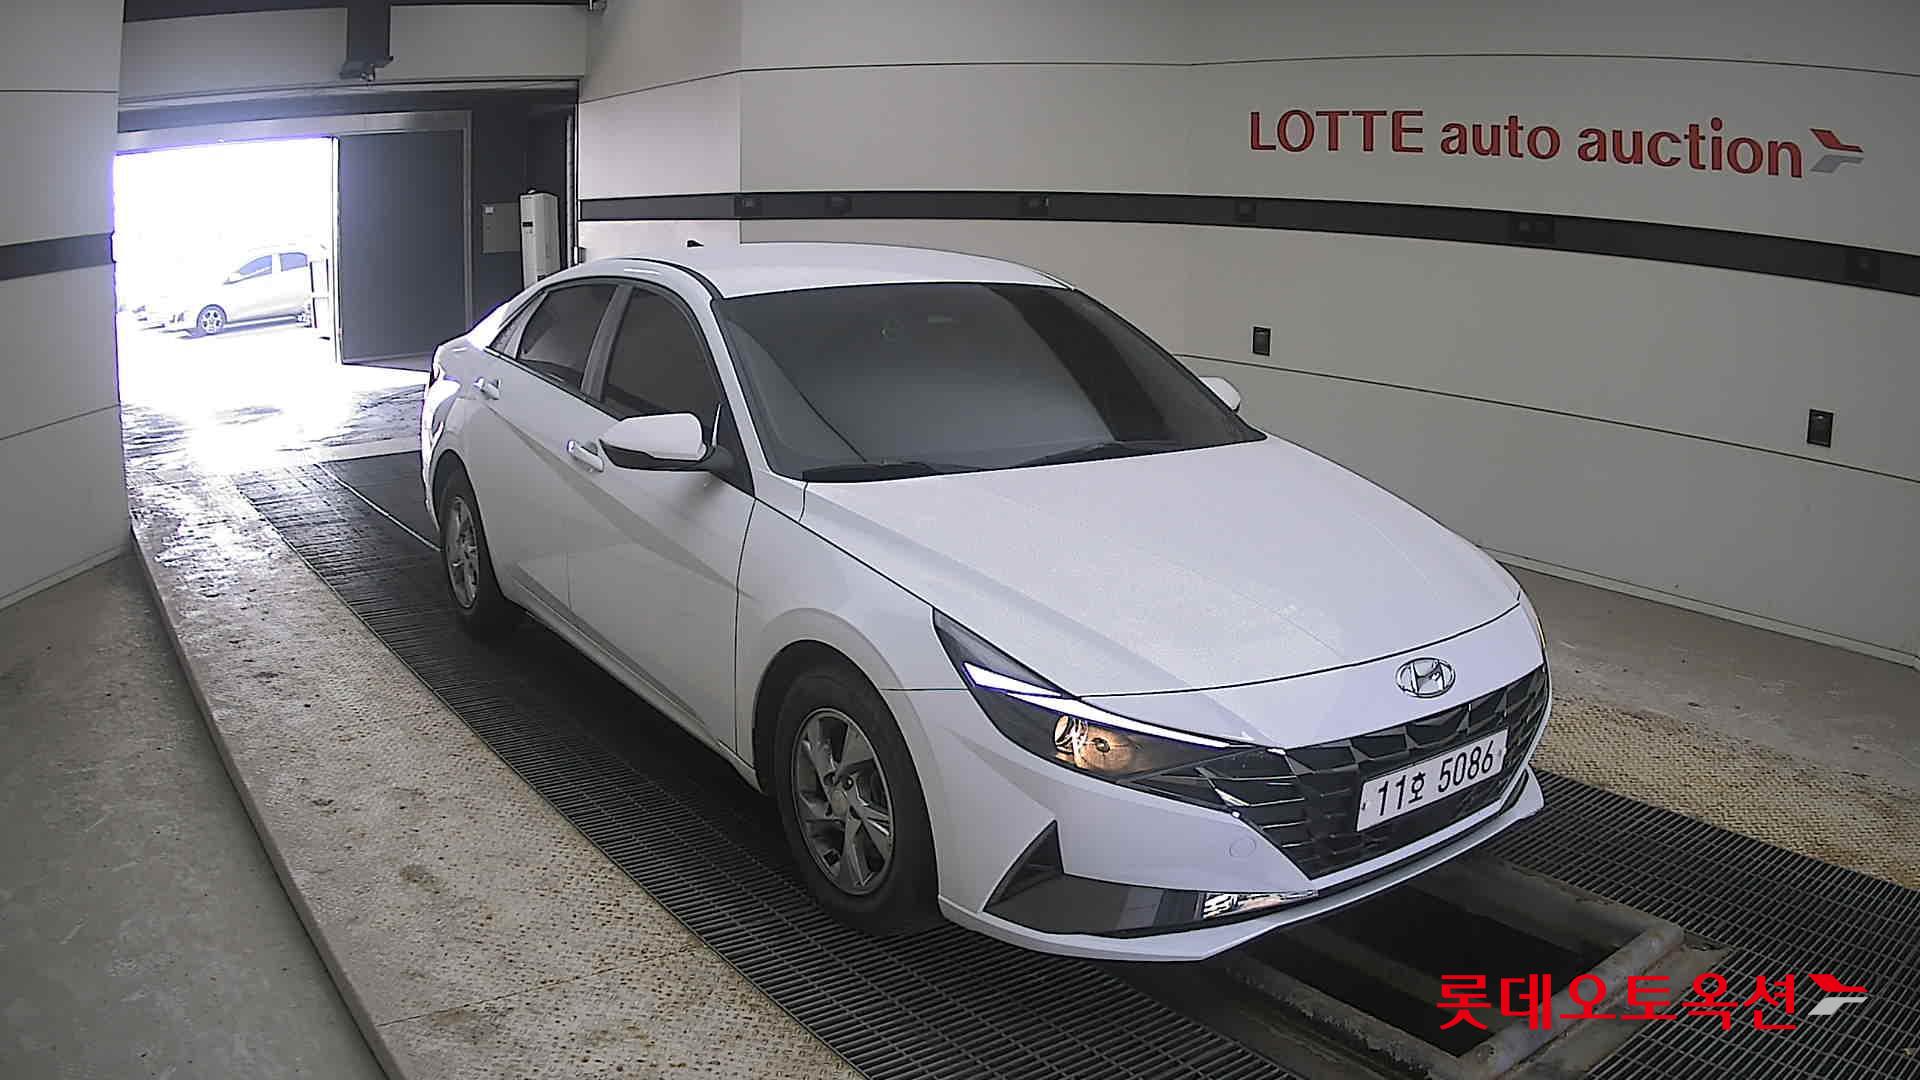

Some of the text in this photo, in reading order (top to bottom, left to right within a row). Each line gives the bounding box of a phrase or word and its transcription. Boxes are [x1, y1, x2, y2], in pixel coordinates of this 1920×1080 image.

[1249, 109, 1804, 178] LOTTE auto auction
[1377, 739, 1495, 817] 11호 5086
